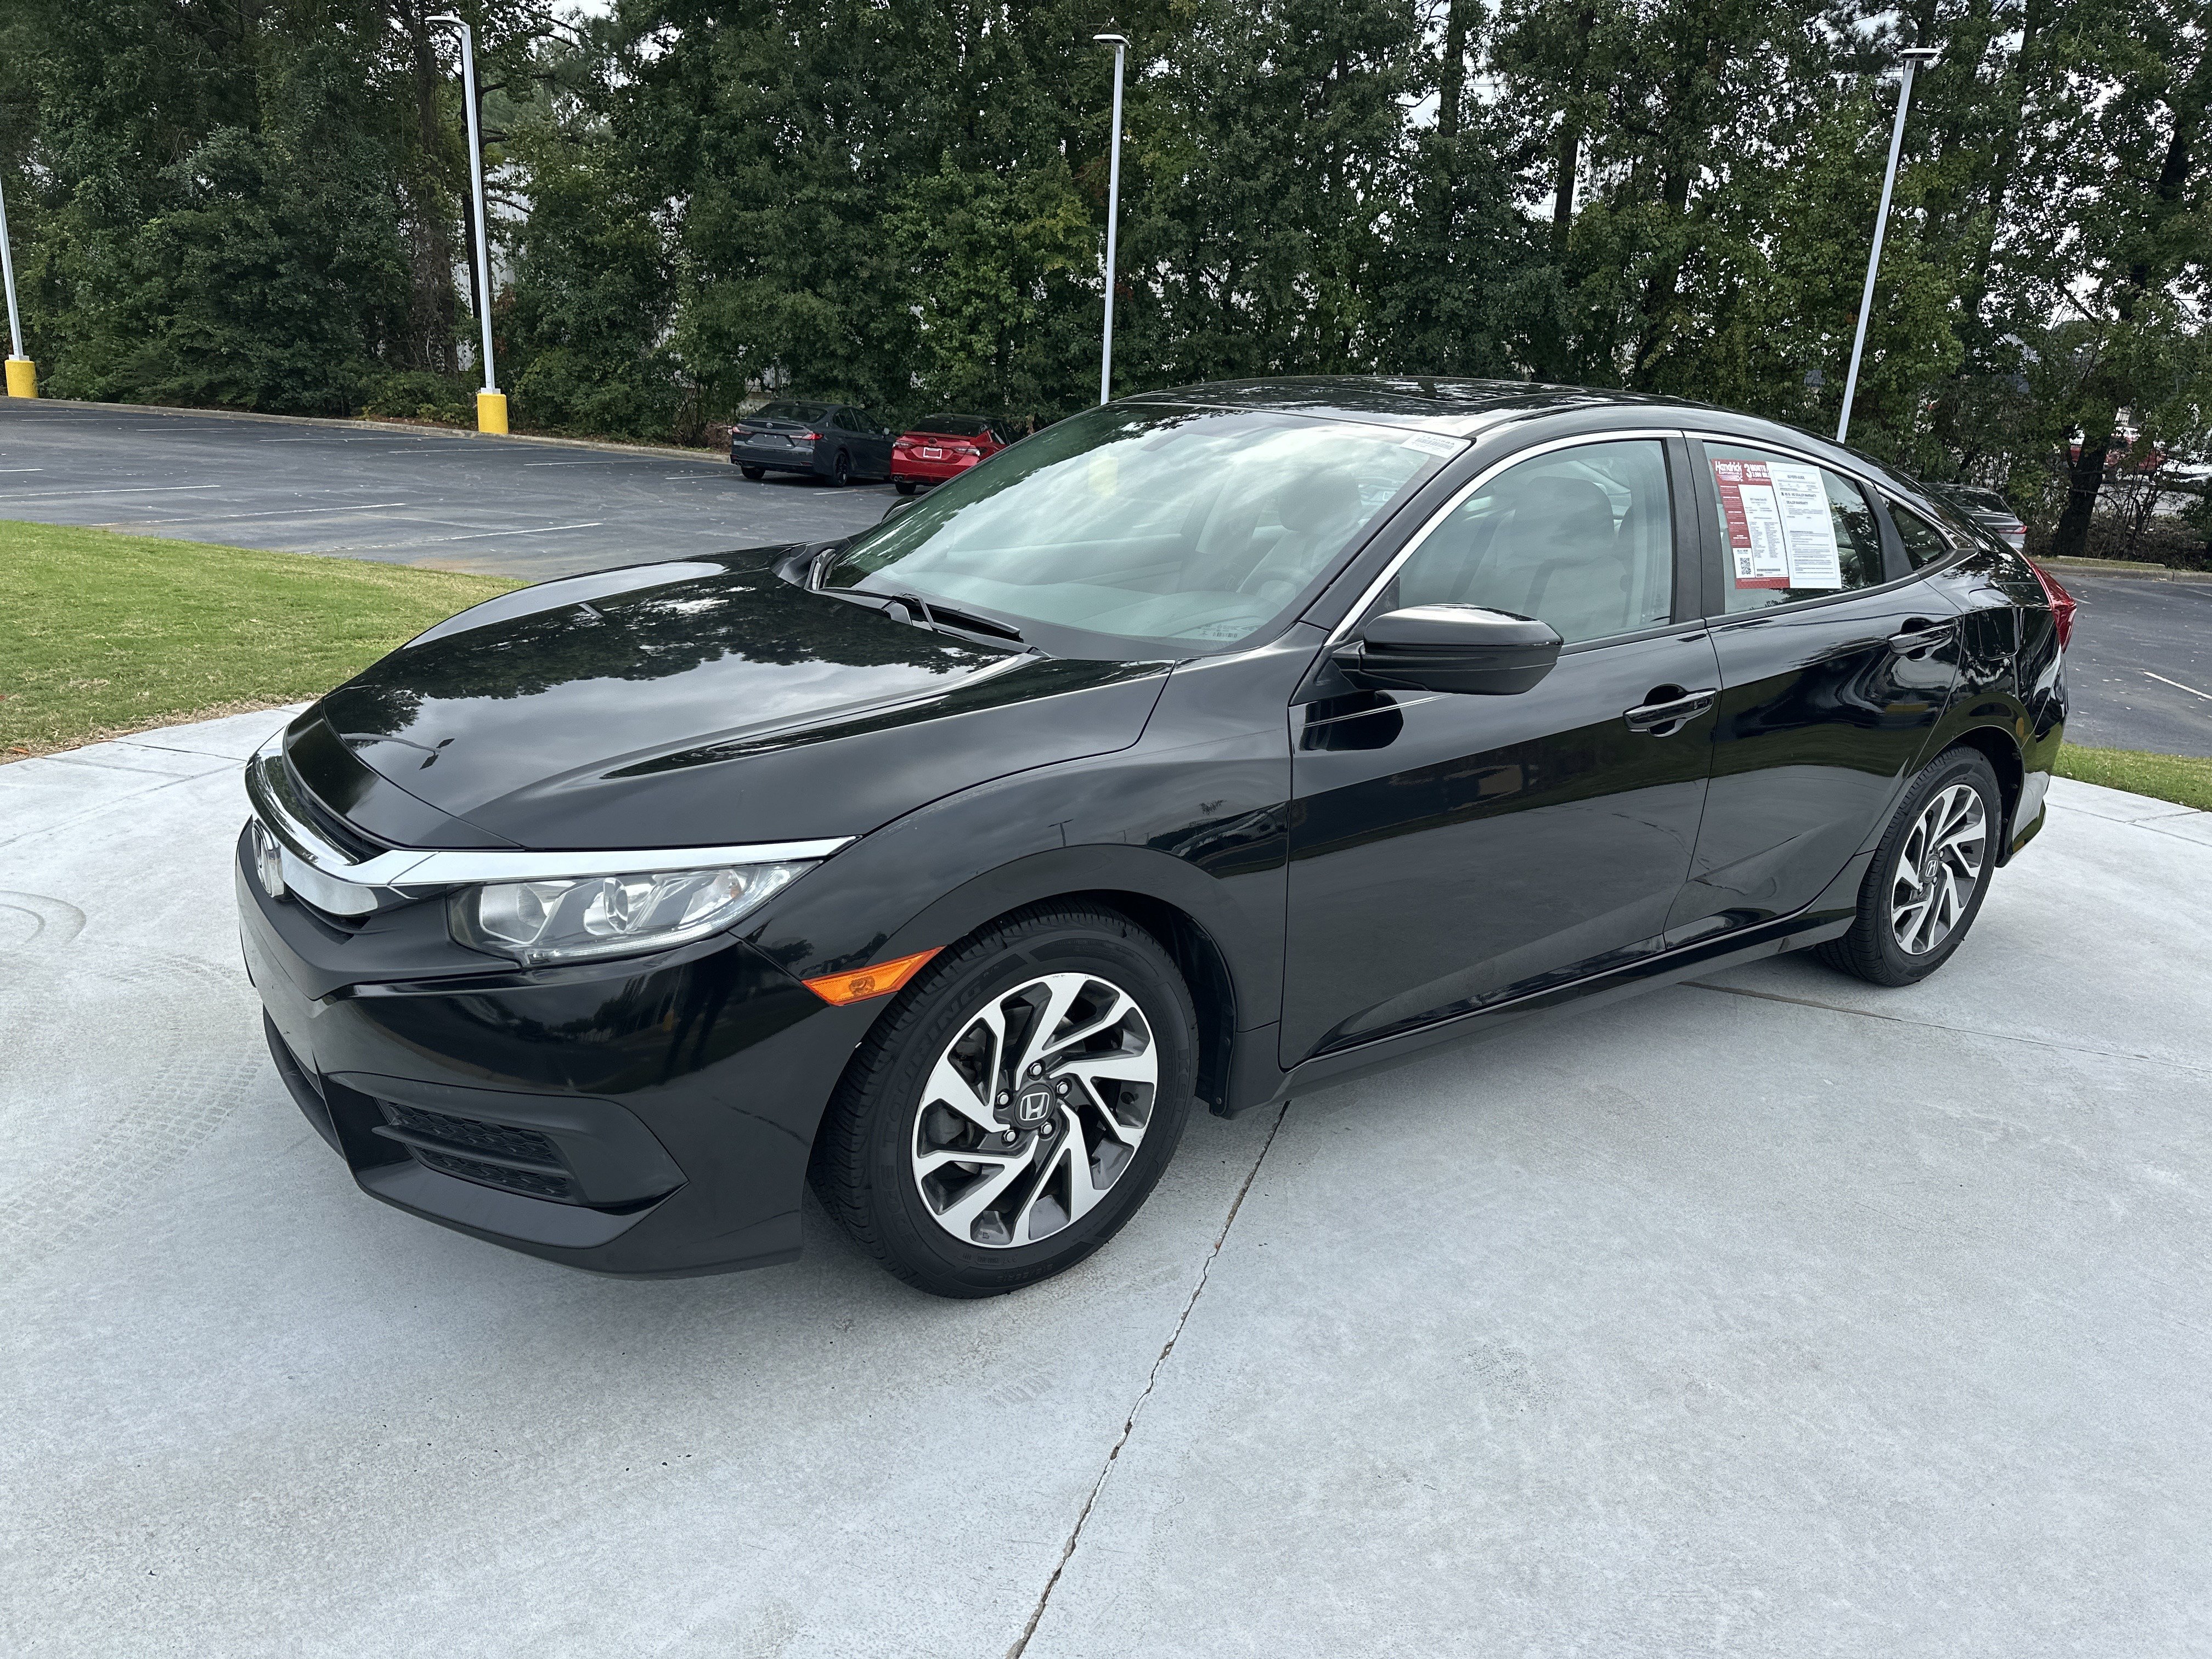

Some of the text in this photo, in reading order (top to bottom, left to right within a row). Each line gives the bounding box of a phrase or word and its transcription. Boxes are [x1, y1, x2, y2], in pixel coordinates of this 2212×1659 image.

[1715, 461, 1742, 473] Hendrick
[1744, 464, 1752, 478] 3
[882, 986, 982, 1148] TOURING
